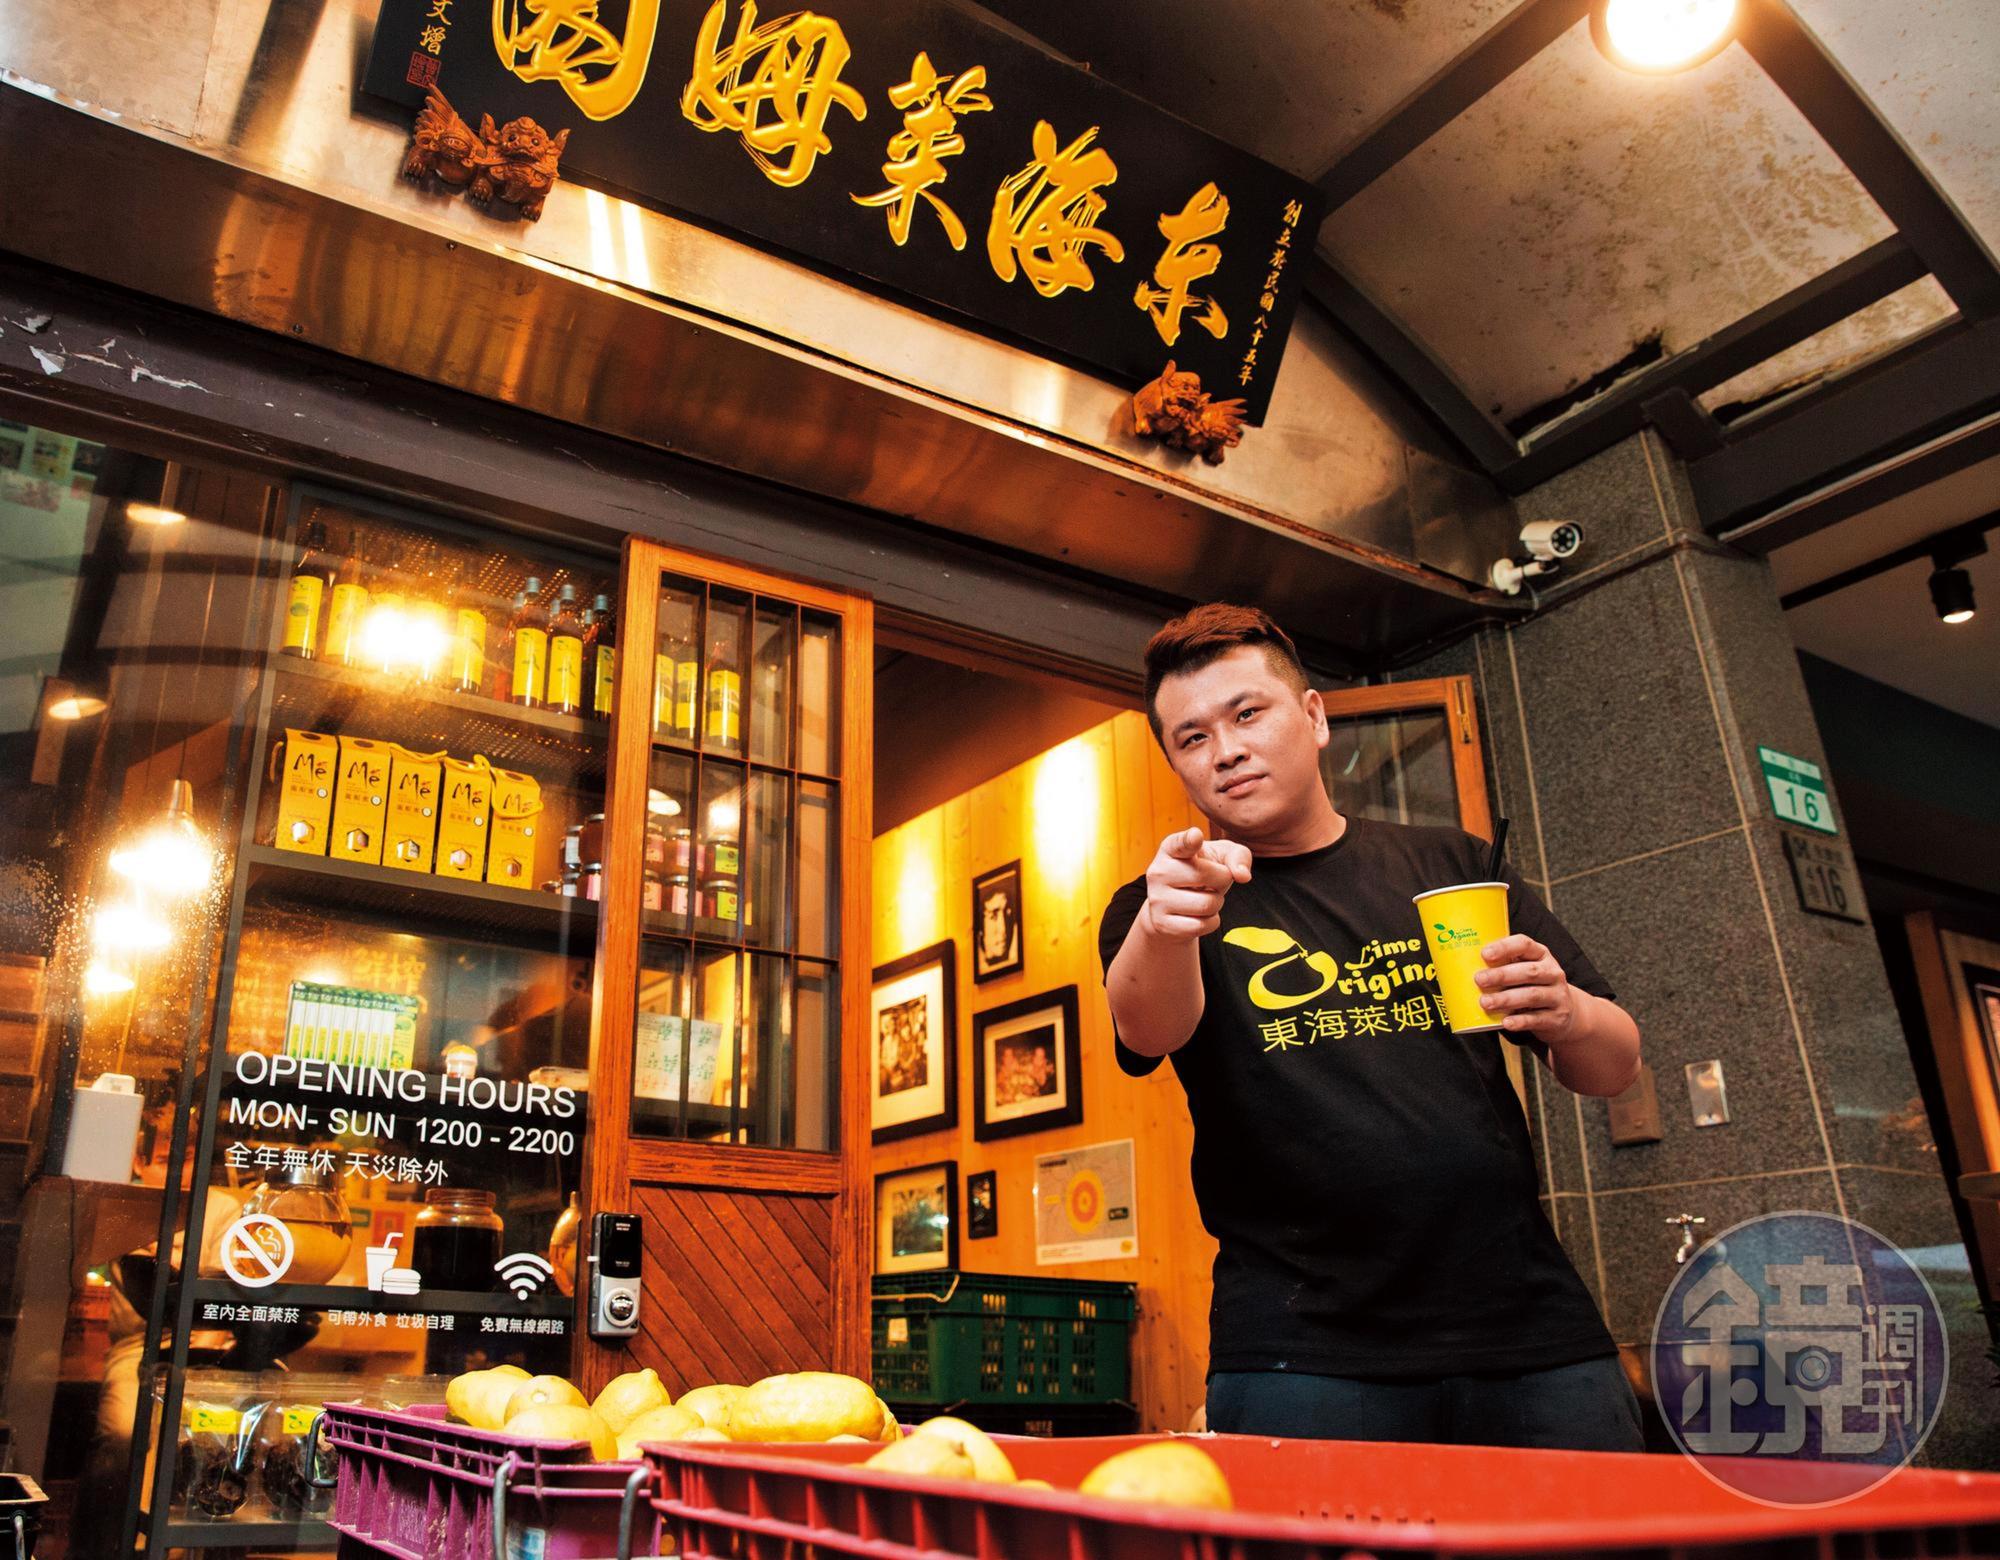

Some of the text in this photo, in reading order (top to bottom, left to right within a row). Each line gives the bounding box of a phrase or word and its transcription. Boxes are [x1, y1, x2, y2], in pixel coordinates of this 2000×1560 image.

[1785, 786, 1819, 822] 16
[1816, 865, 1848, 912] 16
[1344, 938, 1422, 970] Lime
[235, 1050, 576, 1118] OPENING HOURS
[327, 1107, 396, 1139] SUN
[415, 1117, 482, 1148] 1200
[507, 1126, 575, 1156] 2200
[224, 1141, 449, 1186] 全年無休 天災除外
[327, 1309, 455, 1331] 可帶外食 垃圾自理
[479, 1316, 565, 1335] 免費無線網路
